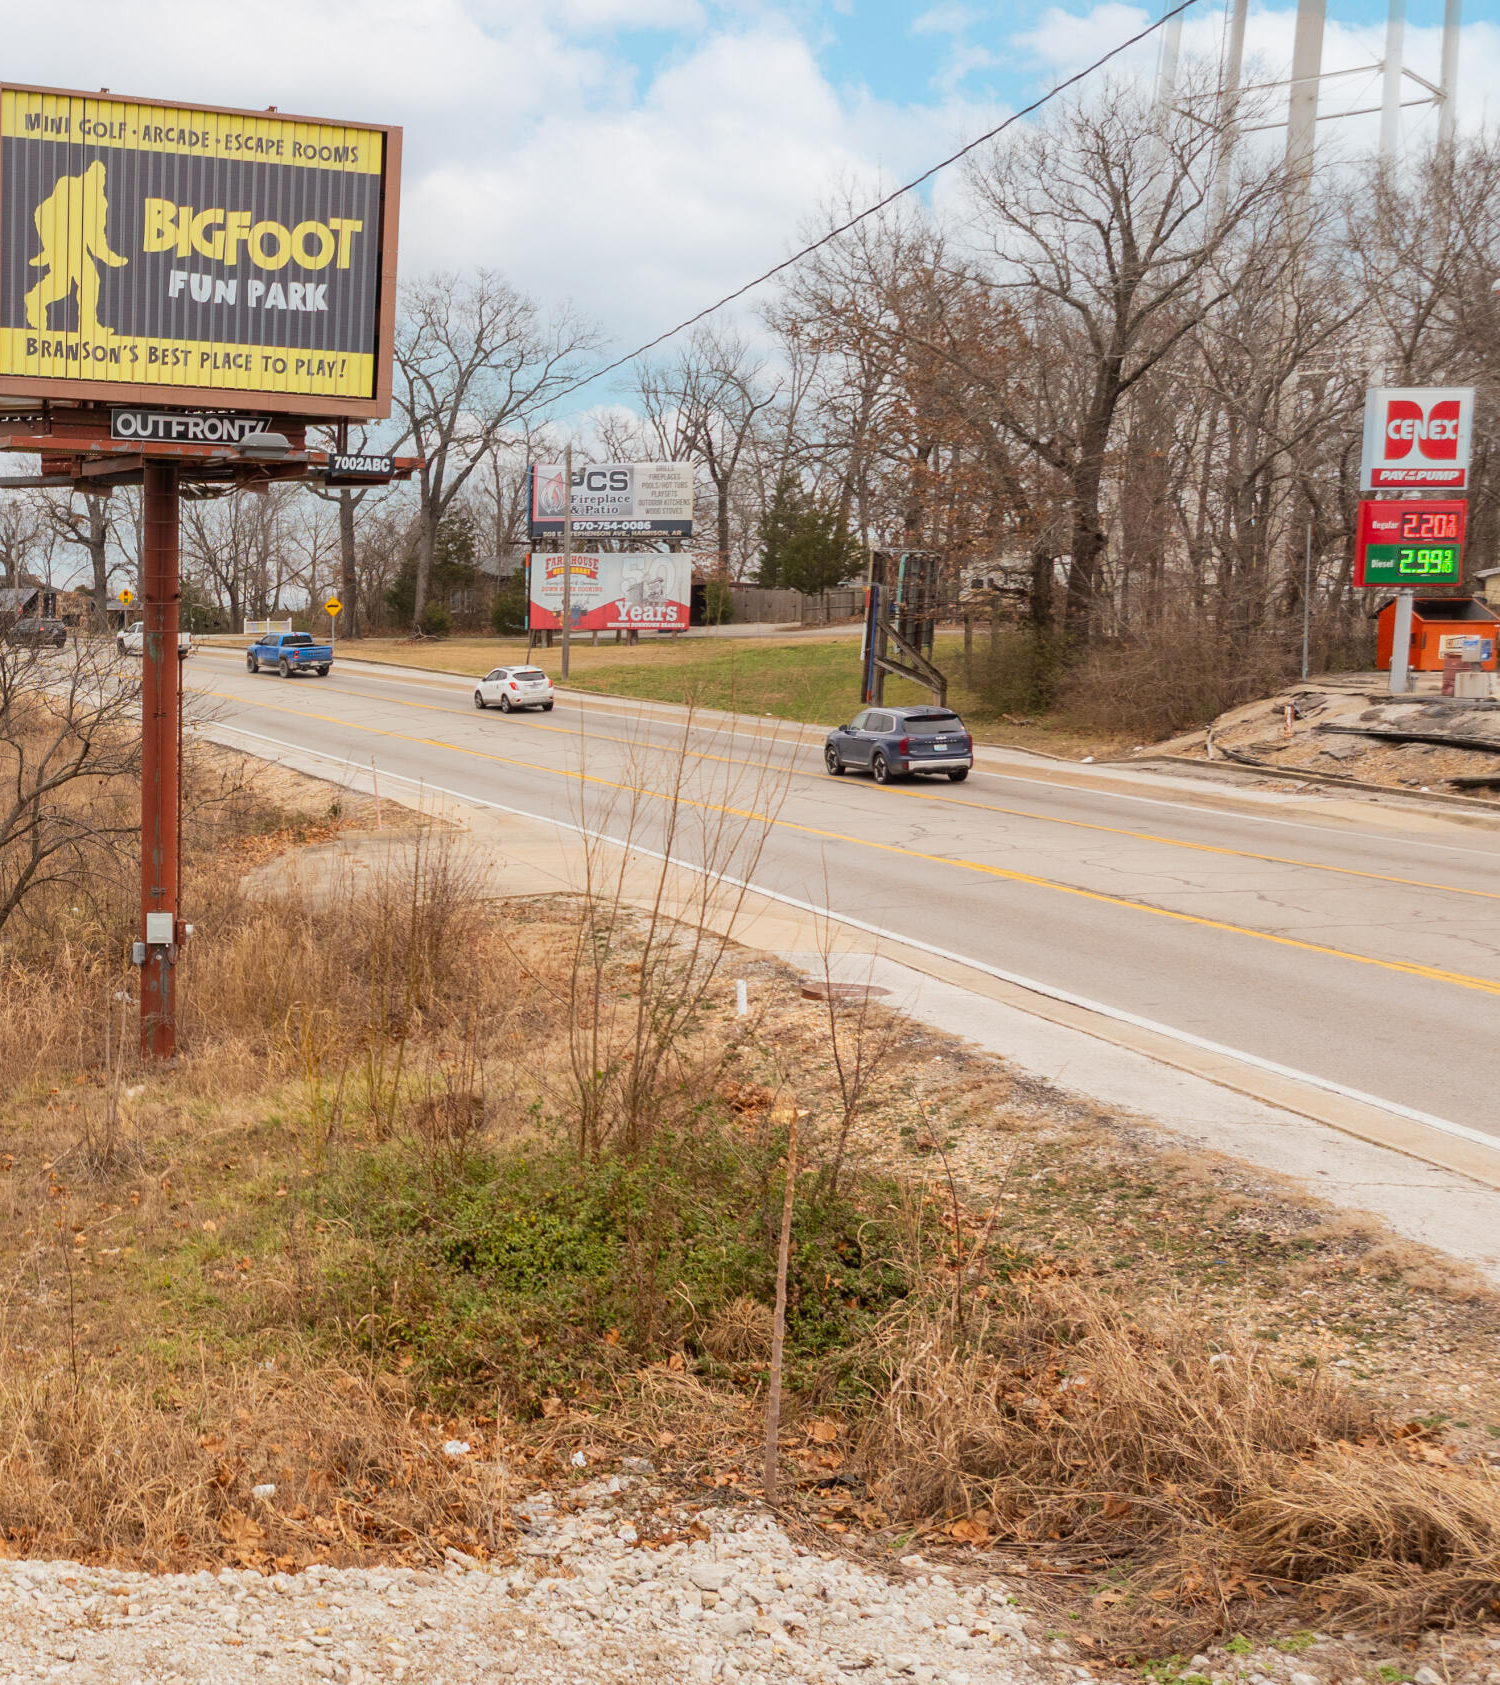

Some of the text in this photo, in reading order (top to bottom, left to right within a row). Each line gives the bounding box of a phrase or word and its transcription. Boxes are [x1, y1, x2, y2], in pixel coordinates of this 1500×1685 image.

[25, 113, 359, 164] MINI GOLF ARCADE ESCAPE ROOMS
[143, 197, 363, 271] BIGFOOT
[168, 269, 329, 312] FUN PARK
[26, 337, 347, 379] BRANSON'S BEST PLACE TO PLAY!
[1387, 418, 1458, 440] CENEX
[333, 455, 391, 473] 7002ABC
[1380, 470, 1406, 481] PAY
[1416, 470, 1460, 481] PUMP
[571, 495, 630, 505] Fireplace
[571, 505, 619, 514] & Patio
[573, 522, 652, 530] 870-754-0086
[1372, 520, 1400, 531] Regular
[1403, 514, 1446, 538] 2.20
[545, 555, 599, 570] FARHOUSE
[1371, 559, 1395, 568] Diesel
[1399, 549, 1443, 574] 2.99
[615, 601, 678, 622] Years
